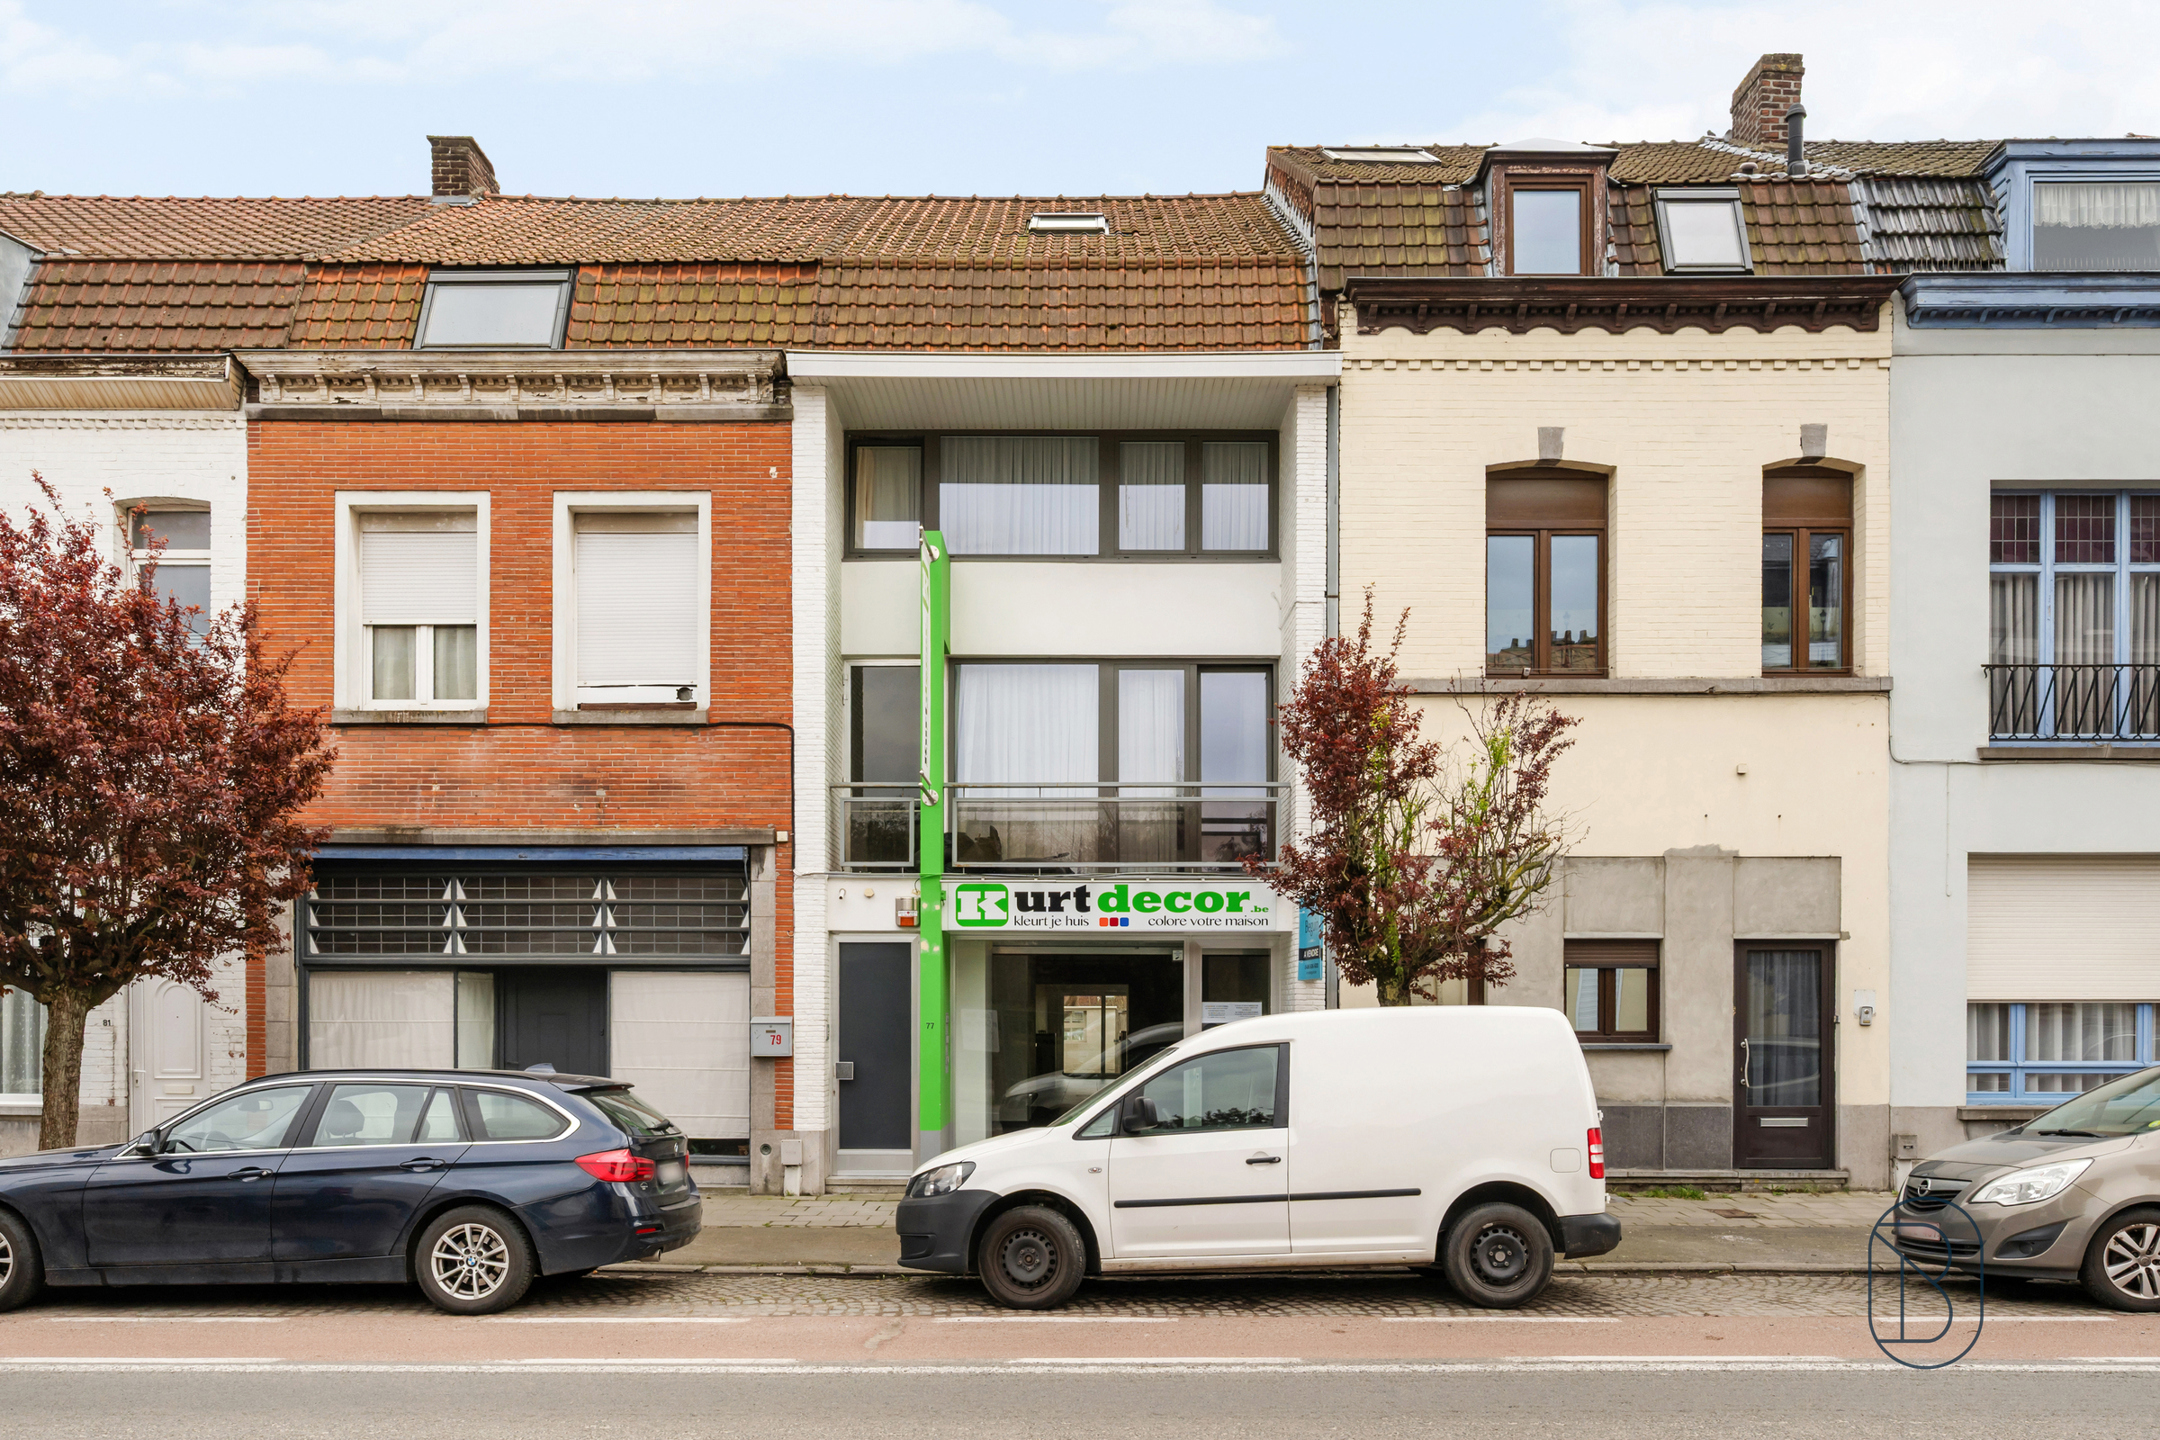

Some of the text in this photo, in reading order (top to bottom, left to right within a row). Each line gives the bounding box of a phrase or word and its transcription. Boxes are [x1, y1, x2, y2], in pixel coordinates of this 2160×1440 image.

[1013, 915, 1090, 929] kleurt je huis
[1147, 915, 1269, 926] colore votre maison
[926, 1022, 935, 1030] 77
[770, 1034, 782, 1046] 79
